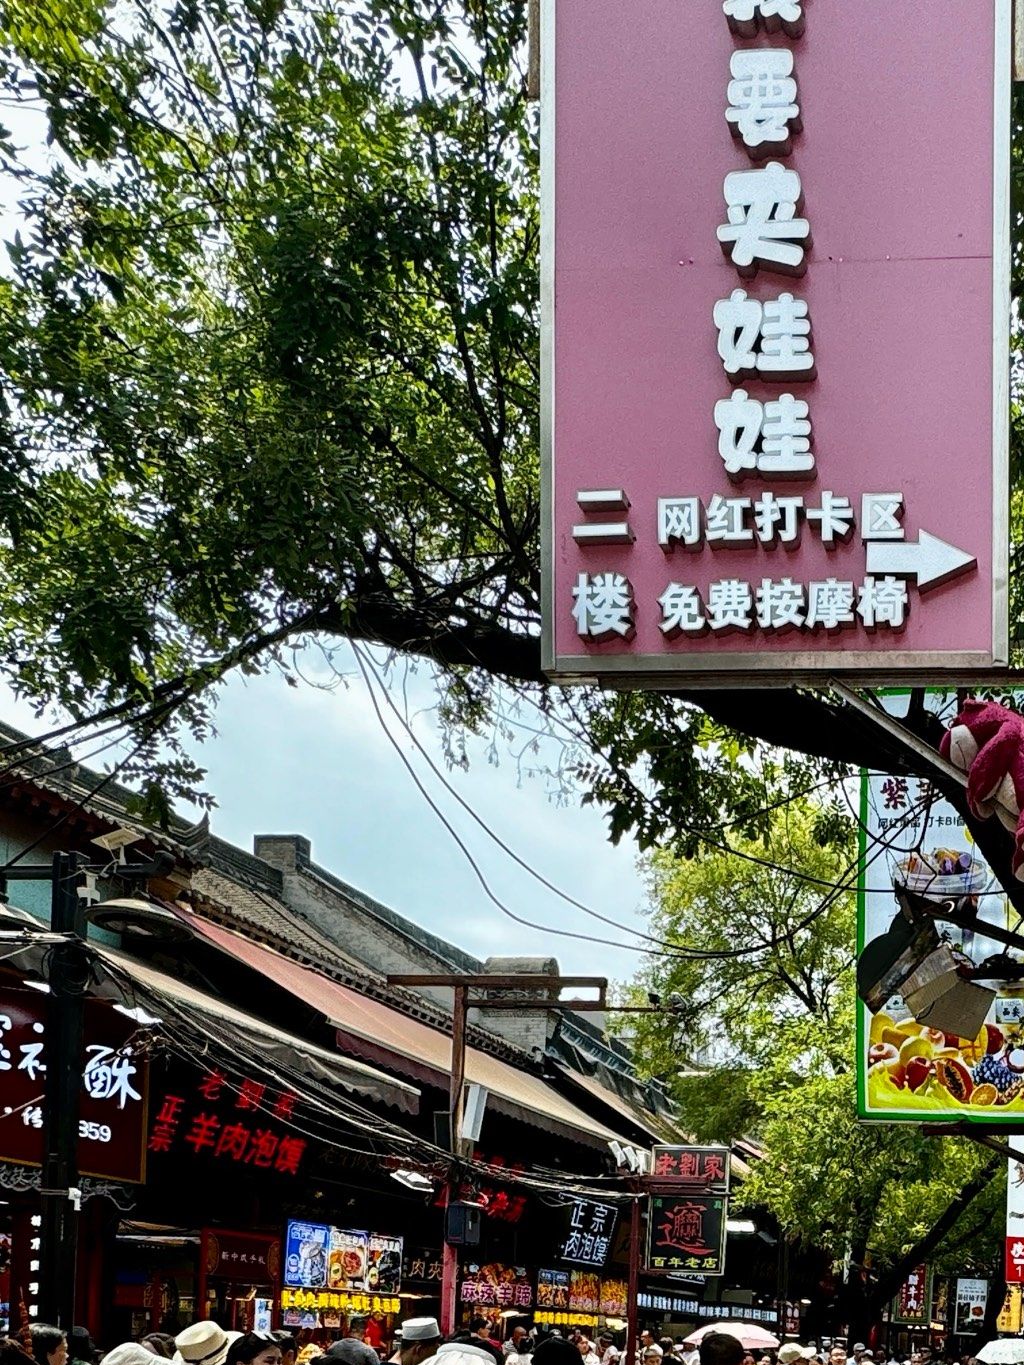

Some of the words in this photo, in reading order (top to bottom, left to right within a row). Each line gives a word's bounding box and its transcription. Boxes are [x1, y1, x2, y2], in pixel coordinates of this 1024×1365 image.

[657, 490, 905, 545] 网红打卡区
[572, 490, 632, 635] 二楼
[658, 575, 909, 630] 免费按摩椅
[571, 1200, 608, 1233] 正宗
[651, 1256, 718, 1269] 百年老店
[461, 1280, 533, 1307] 麻辣羊蹄
